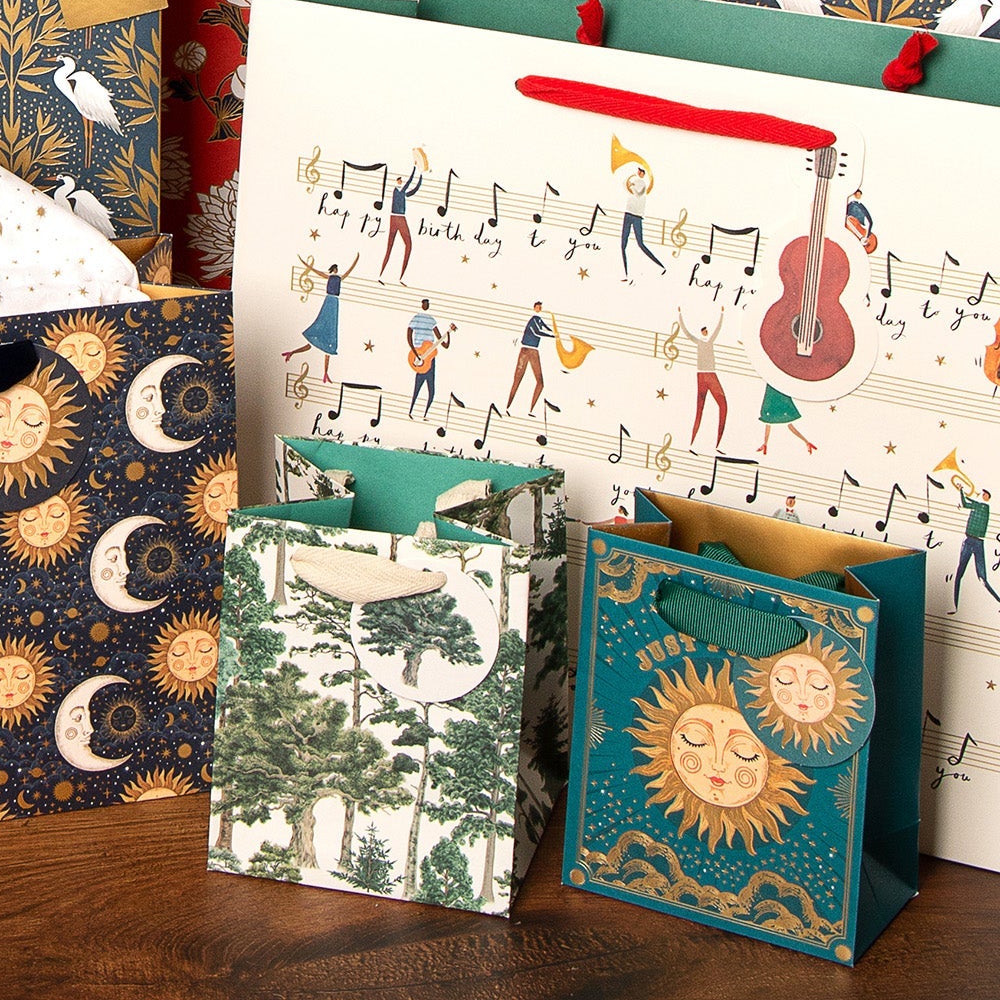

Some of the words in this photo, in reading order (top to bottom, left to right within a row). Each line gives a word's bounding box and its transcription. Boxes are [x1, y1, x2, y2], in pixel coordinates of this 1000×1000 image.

[564, 237, 602, 261] you
[950, 306, 991, 331] you
[610, 484, 636, 506] yo
[635, 632, 697, 671] JUST
[930, 765, 971, 790] you
